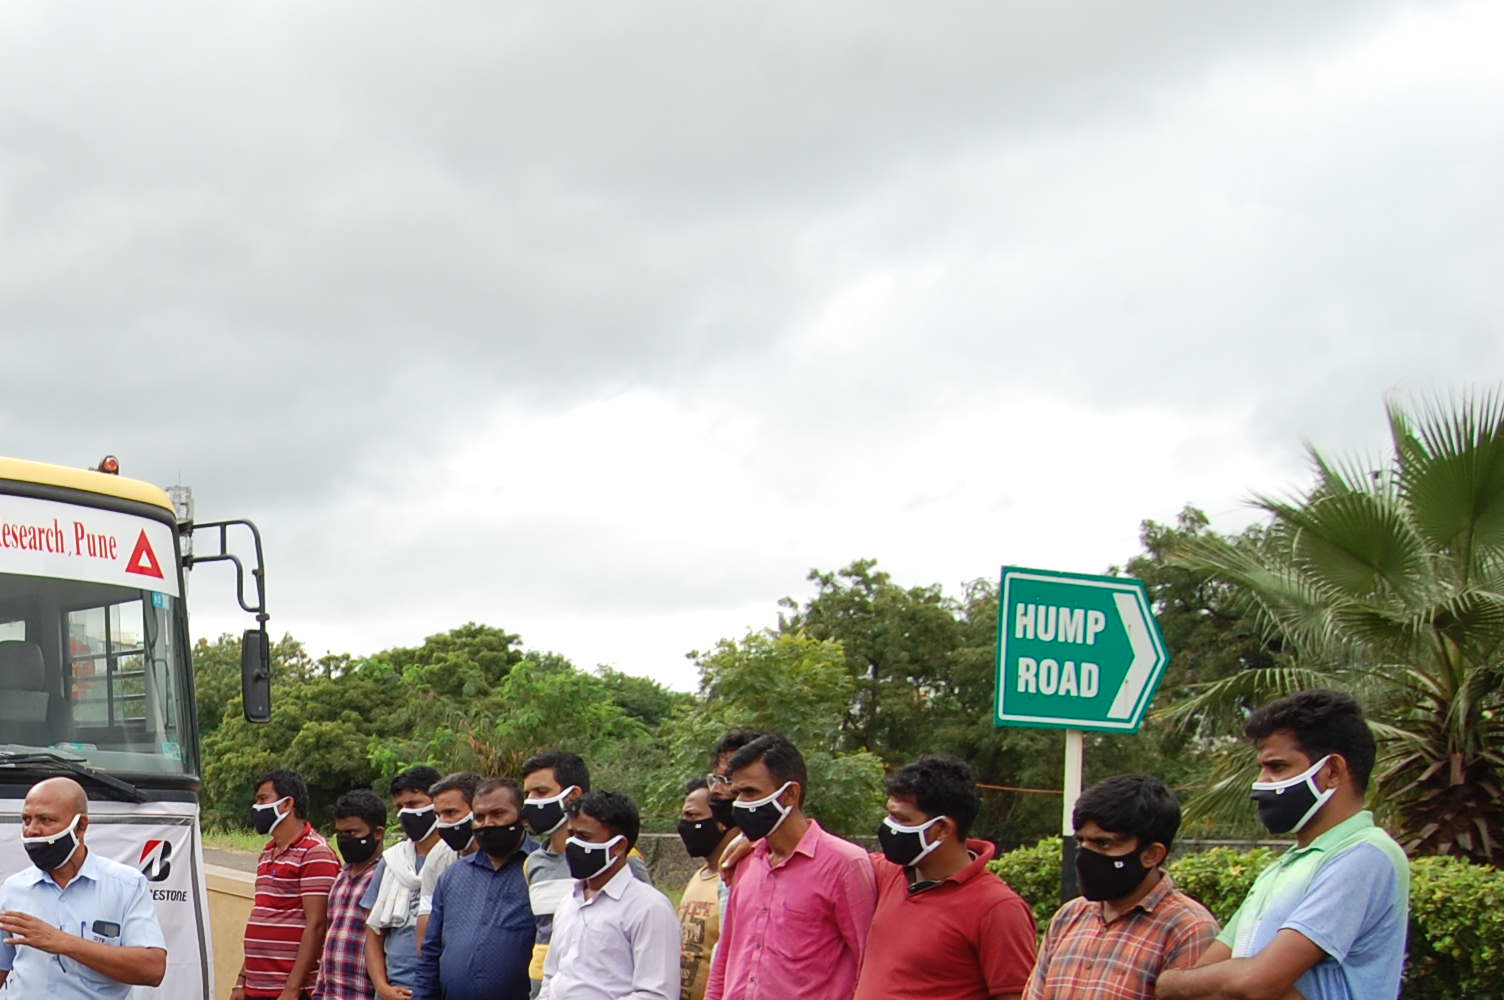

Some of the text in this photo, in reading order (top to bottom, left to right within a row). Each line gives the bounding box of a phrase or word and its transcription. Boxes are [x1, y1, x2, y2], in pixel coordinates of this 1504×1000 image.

[73, 521, 118, 561] Pune
[1015, 603, 1106, 645] HUMP
[1017, 656, 1100, 698] ROAD
[150, 889, 187, 902] ESTONE
